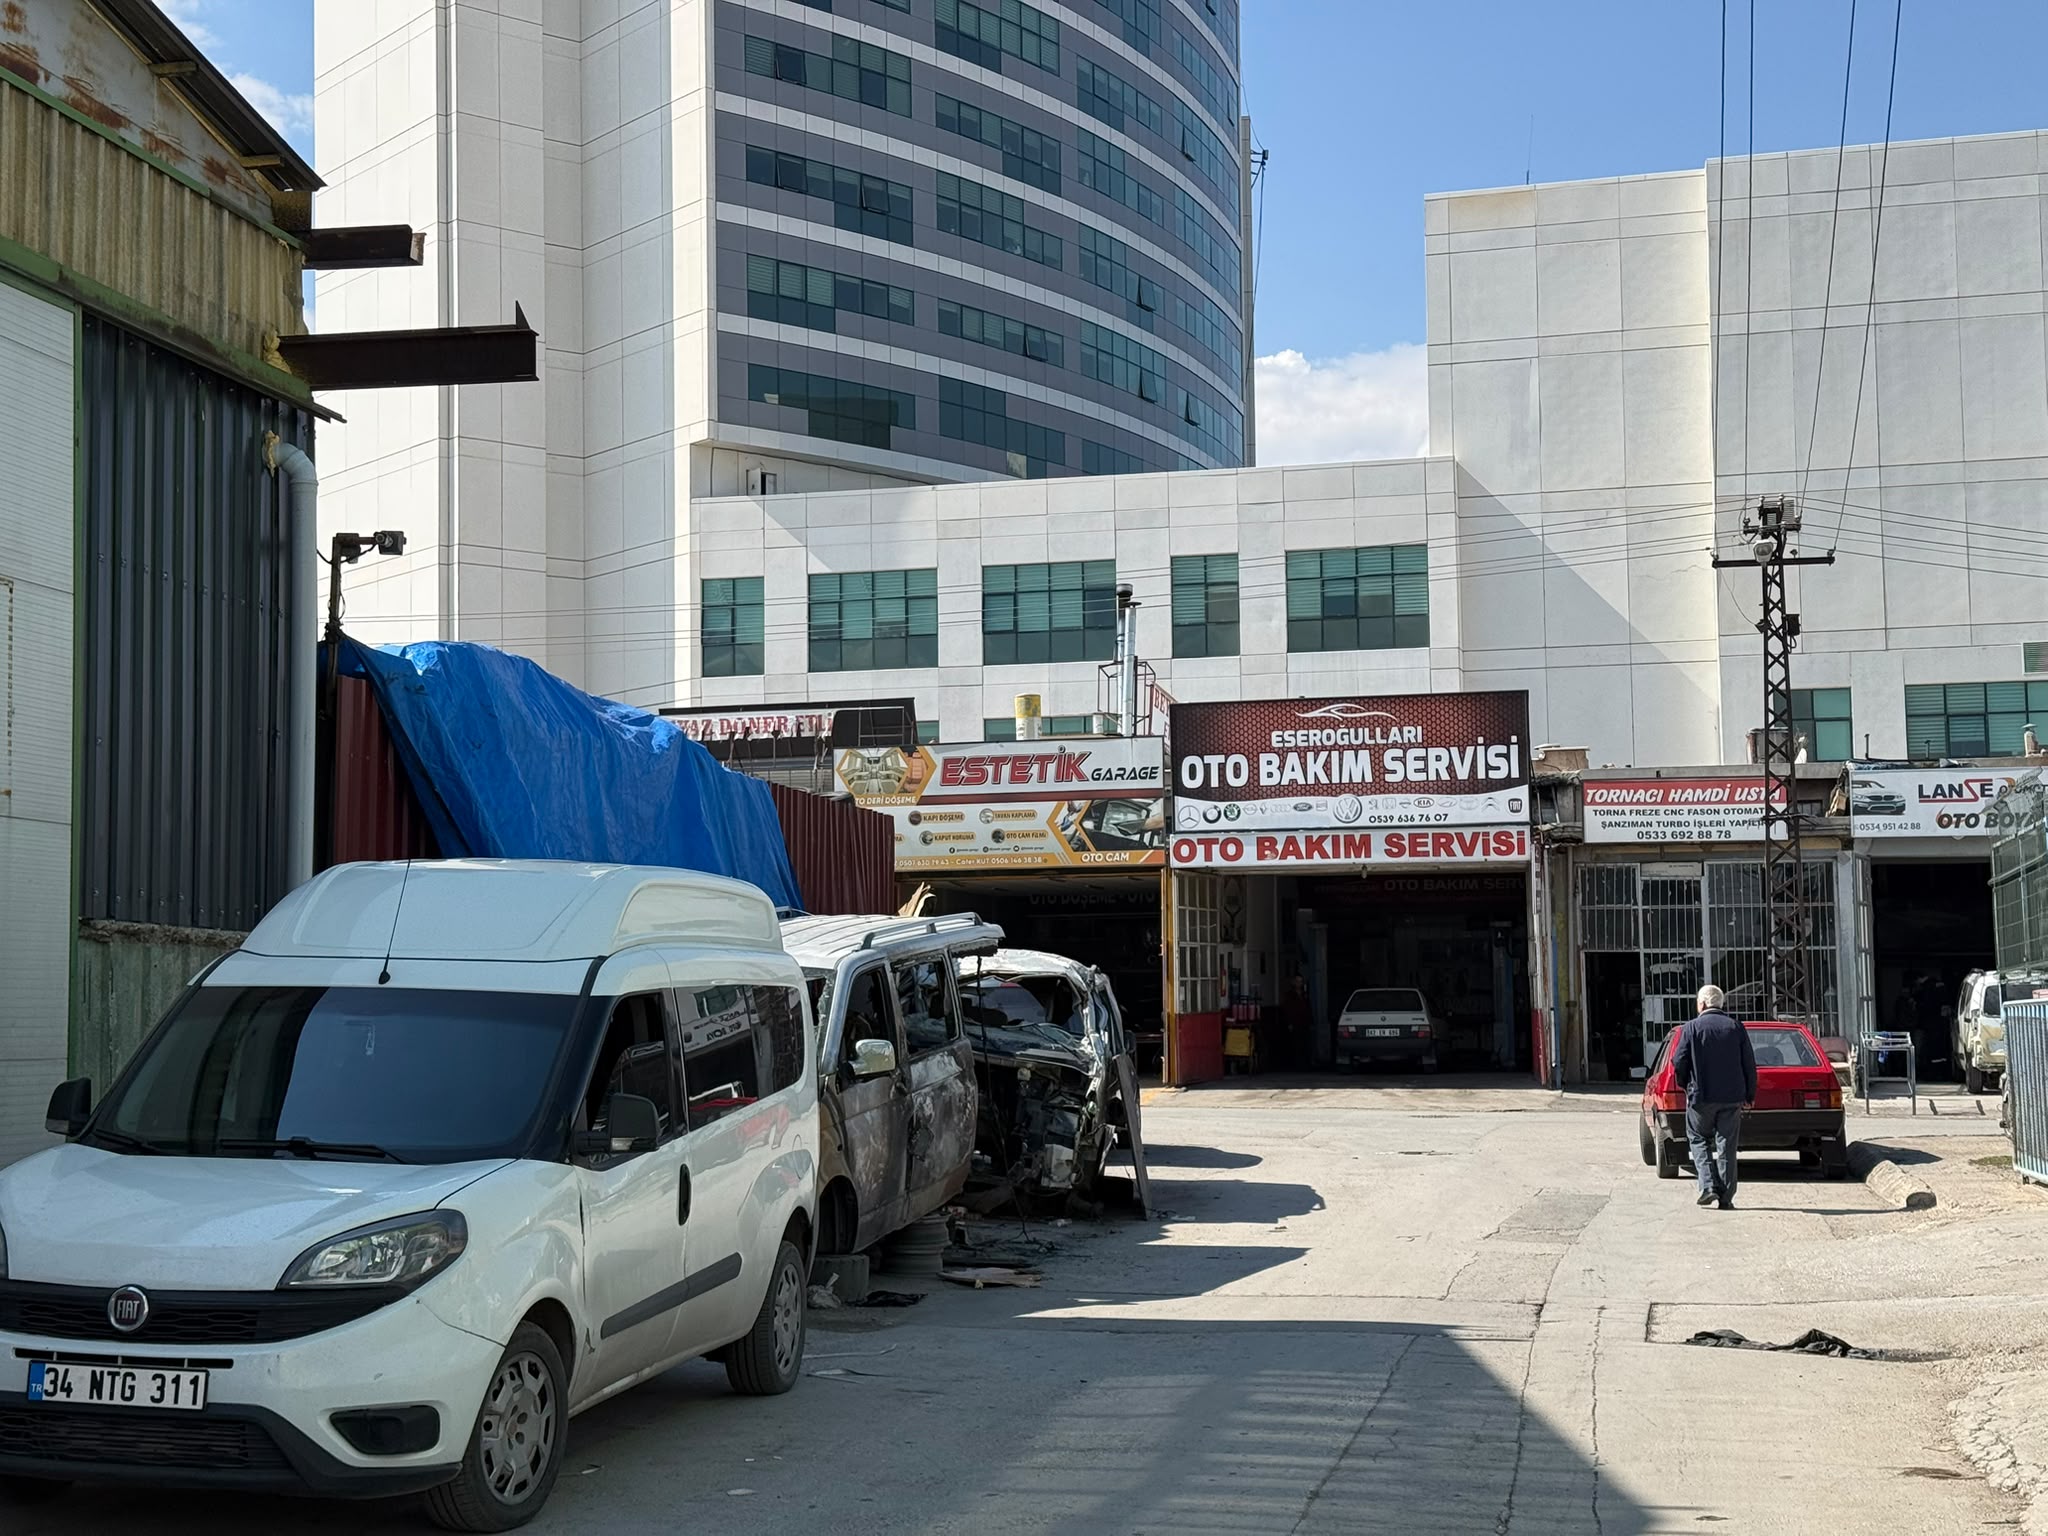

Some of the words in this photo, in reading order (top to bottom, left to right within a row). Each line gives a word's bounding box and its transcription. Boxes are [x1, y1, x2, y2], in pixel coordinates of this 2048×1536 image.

[719, 715, 789, 736] DÖNER
[1271, 724, 1423, 748] ESEROĞULLARI
[939, 744, 1092, 786] ESTETİK
[1091, 766, 1160, 782] GARAGE
[1181, 753, 1249, 789] OTO
[1259, 750, 1373, 786] BAKIM
[1384, 735, 1520, 783] SERVİSİ
[1586, 788, 1664, 804] TORNACI
[1668, 783, 1732, 803] HAMDİ
[885, 794, 917, 806] DÖŞEME
[923, 814, 940, 822] KAPI
[1593, 809, 1627, 817] TORNA
[1629, 808, 1661, 817] FREZE
[1663, 808, 1684, 816] CNC
[1687, 807, 1720, 816] FASON
[1369, 814, 1394, 824] 0539
[1397, 814, 1415, 823] 636
[1418, 813, 1431, 822] 76
[1434, 813, 1449, 822] 07
[1601, 820, 1653, 829] ŞANZIMAN
[1656, 820, 1690, 828] TURBO
[1693, 818, 1726, 830] İŞLERİ
[1936, 812, 1980, 829] OTO
[1859, 823, 1881, 831] 0534
[1882, 822, 1896, 830] 951
[1898, 822, 1909, 830] 42
[1910, 822, 1921, 830] 88
[1637, 830, 1667, 840] 0533
[1671, 830, 1693, 839] 692
[1697, 830, 1712, 839] 88
[1716, 829, 1732, 839] 78
[1173, 836, 1244, 863] OTO
[1256, 833, 1372, 861] BAKIM
[991, 856, 1009, 864] 0506
[1081, 852, 1104, 863] OTO
[1105, 851, 1130, 862] CAM
[1384, 879, 1418, 891] OTO
[1423, 878, 1479, 890] BAKIM
[116, 1300, 140, 1320] FIAT
[31, 1383, 42, 1393] TR
[43, 1367, 73, 1399] 34
[89, 1369, 136, 1402] NTG
[149, 1373, 200, 1406] 311
